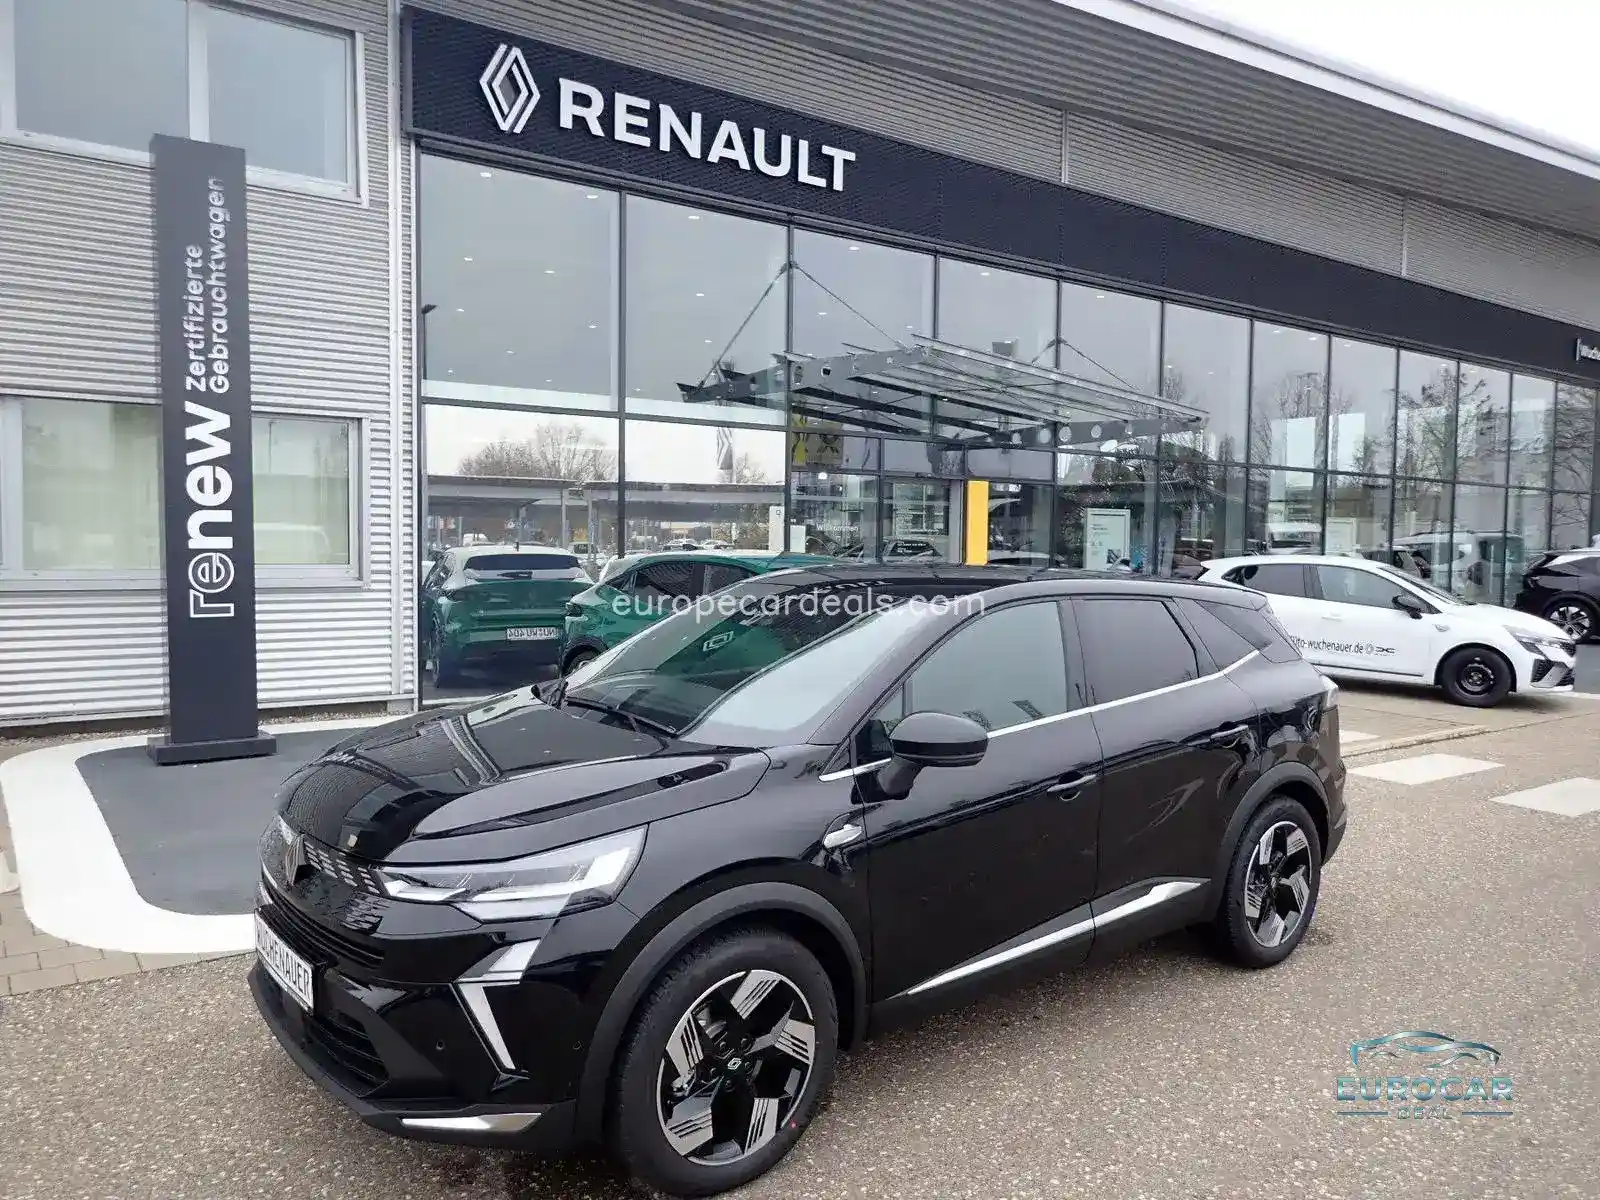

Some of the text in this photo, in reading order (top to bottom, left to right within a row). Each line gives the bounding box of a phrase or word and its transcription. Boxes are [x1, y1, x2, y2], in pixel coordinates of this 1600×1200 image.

[558, 77, 856, 192] RENAULT
[182, 243, 206, 392] Zertifizierte
[207, 175, 231, 394] Gebrauchtwagen
[184, 400, 235, 619] renew
